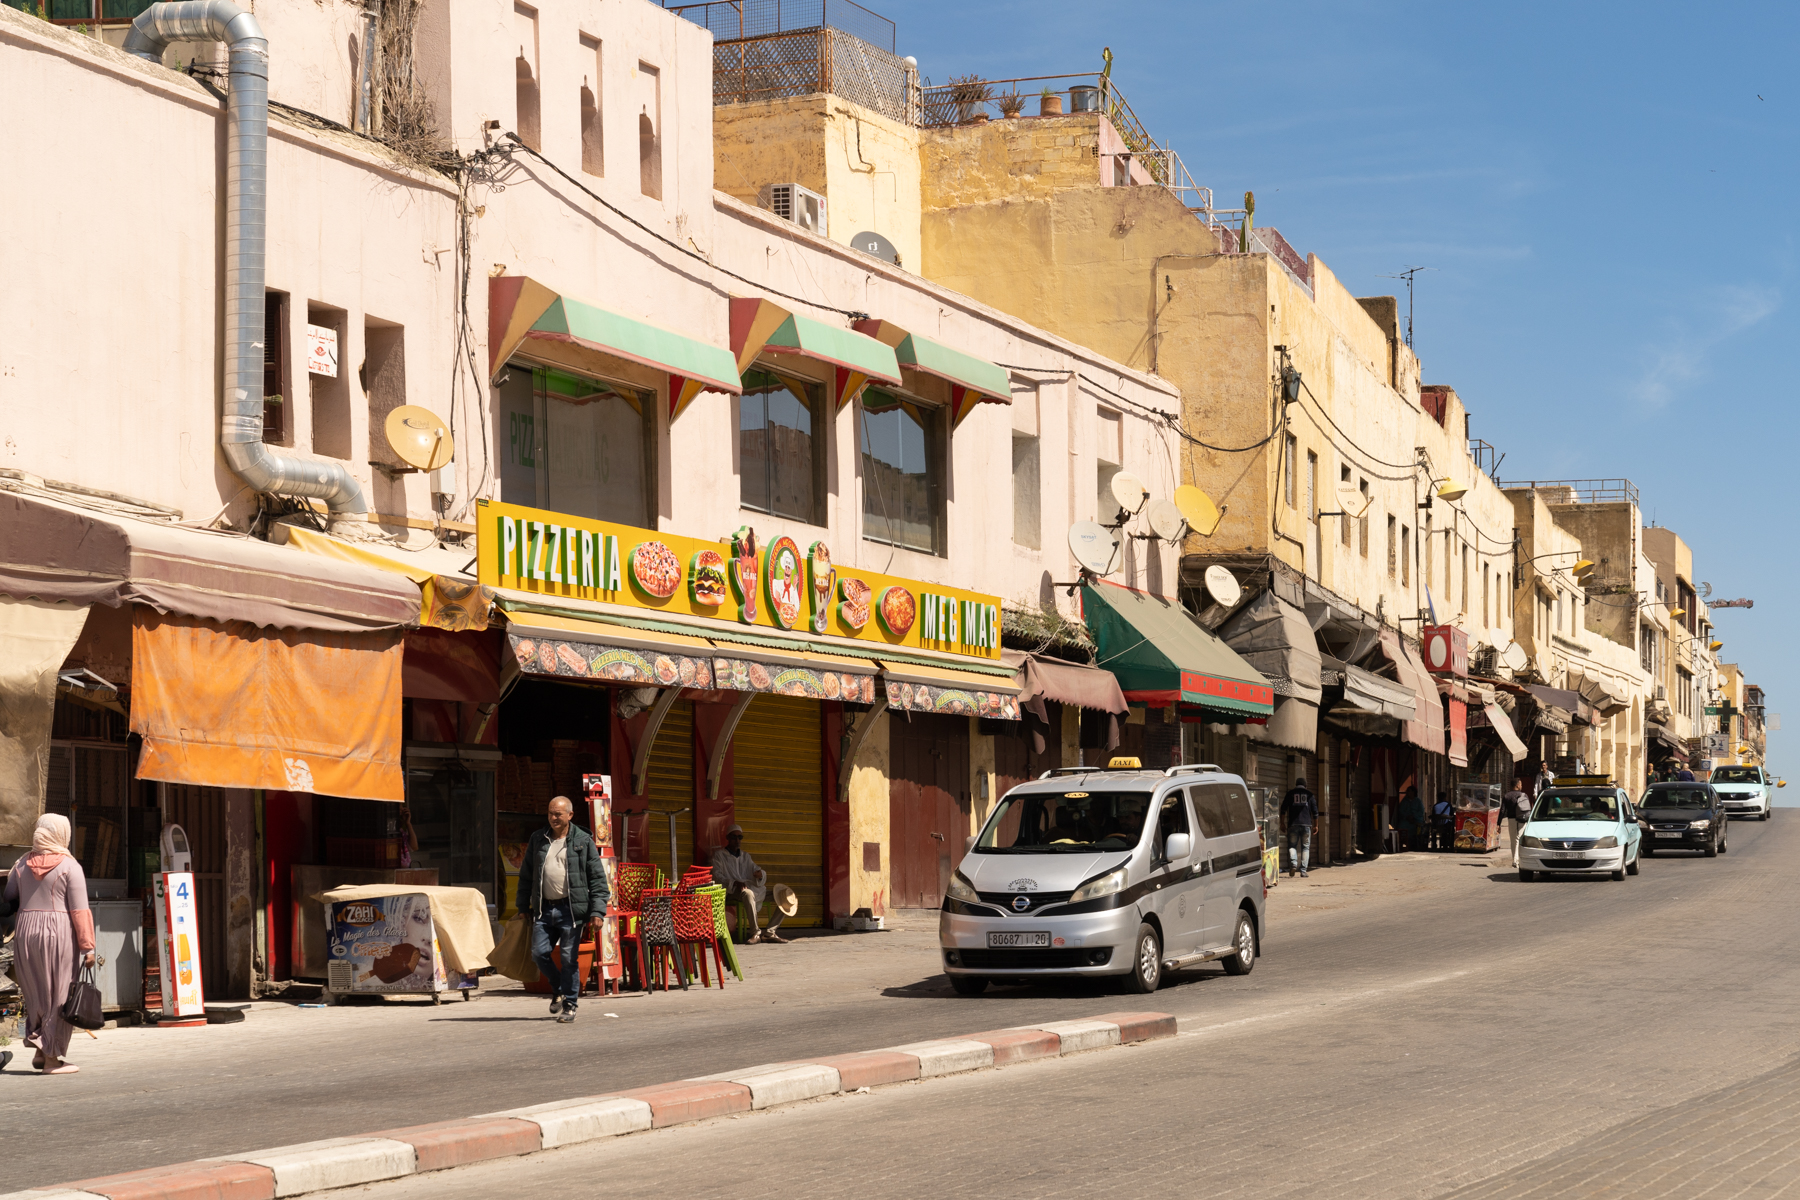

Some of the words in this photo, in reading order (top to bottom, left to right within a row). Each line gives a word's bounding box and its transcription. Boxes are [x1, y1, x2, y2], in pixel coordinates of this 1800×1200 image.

[499, 515, 622, 591] PIZZERIA
[922, 593, 958, 643] MEG
[962, 600, 997, 649] MAG
[591, 650, 620, 673] PIZZERIA
[620, 650, 636, 665] MEG
[636, 655, 652, 676] MAG
[1294, 794, 1307, 803] 10
[156, 880, 164, 898] 3
[177, 882, 189, 900] 4
[346, 906, 374, 922] ZAHI
[343, 930, 364, 942] Magie
[367, 926, 380, 936] des
[384, 926, 408, 937] Glaces
[993, 934, 1020, 945] 80687
[1035, 934, 1046, 944] 20
